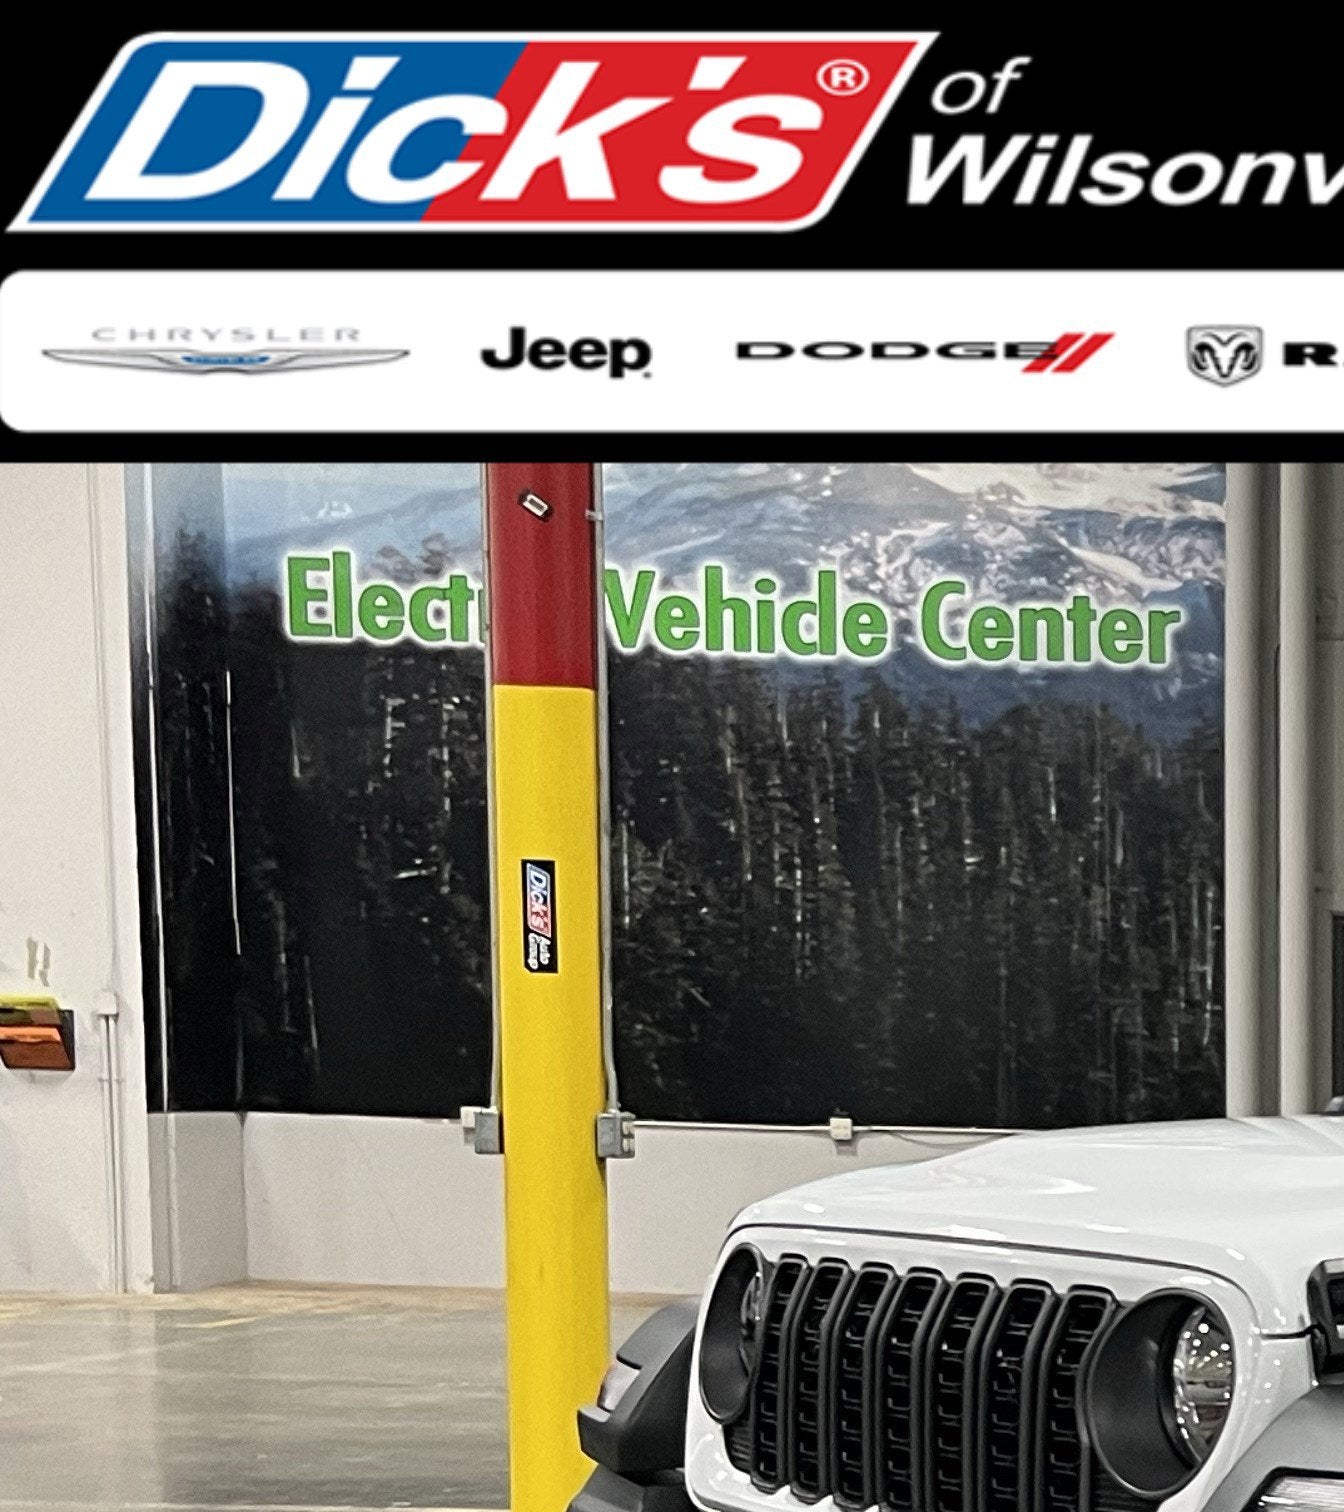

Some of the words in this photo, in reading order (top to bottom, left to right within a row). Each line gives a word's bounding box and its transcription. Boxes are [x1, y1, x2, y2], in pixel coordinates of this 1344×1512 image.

[287, 551, 486, 643] Elect
[604, 564, 889, 659] Vehicle
[921, 580, 1182, 665] Center
